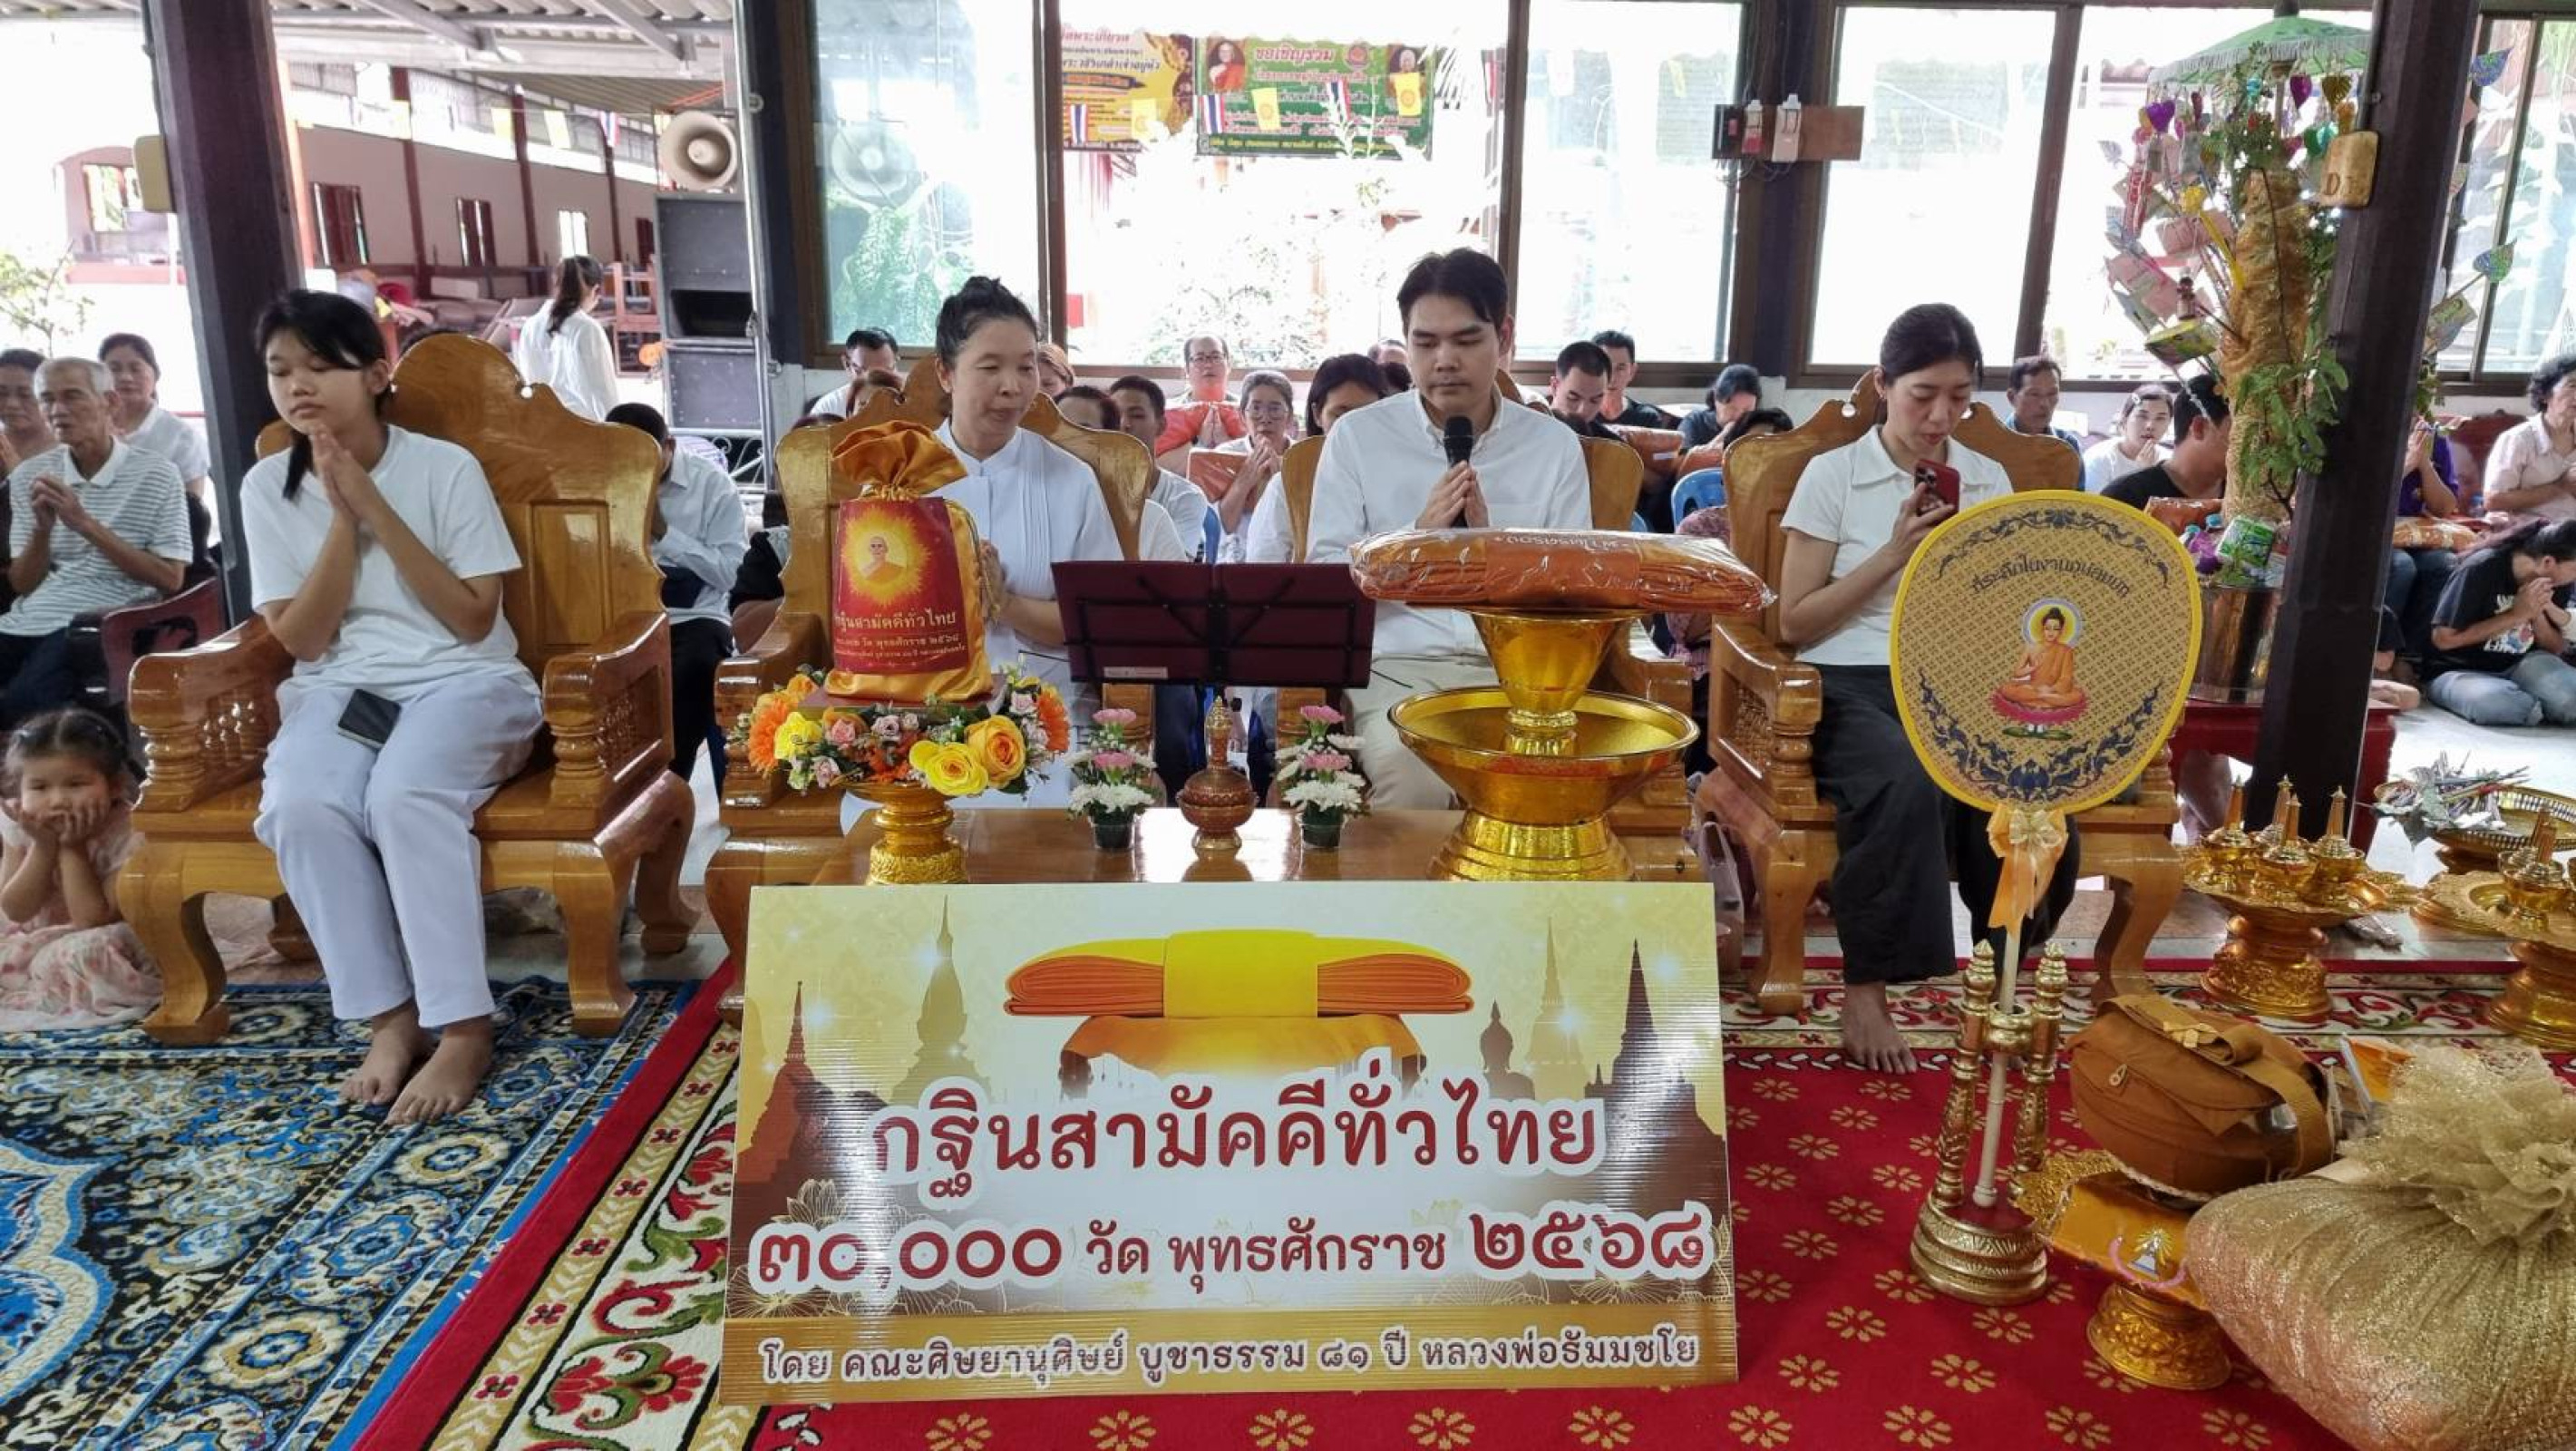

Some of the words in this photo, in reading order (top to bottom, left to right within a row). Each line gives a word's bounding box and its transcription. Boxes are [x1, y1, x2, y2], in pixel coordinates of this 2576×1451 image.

[870, 1057, 1598, 1197] กฐินสามัคคีทั่วไทย
[758, 1224, 1063, 1288] ๓๐,๐๐๐
[1087, 1219, 1150, 1275] วัด
[1168, 1216, 1446, 1294] พุทธศักราช
[1470, 1210, 1707, 1270] ๒๕๖๘
[764, 1342, 828, 1377] โดย
[844, 1332, 1126, 1383] คณะศิษยานุศิษย์
[1142, 1340, 1305, 1386] บูชาธรรม
[1321, 1343, 1368, 1370] ๘๑
[1385, 1332, 1408, 1366] ปี
[1424, 1326, 1698, 1367] หลวงพ่อธัมมชโย
